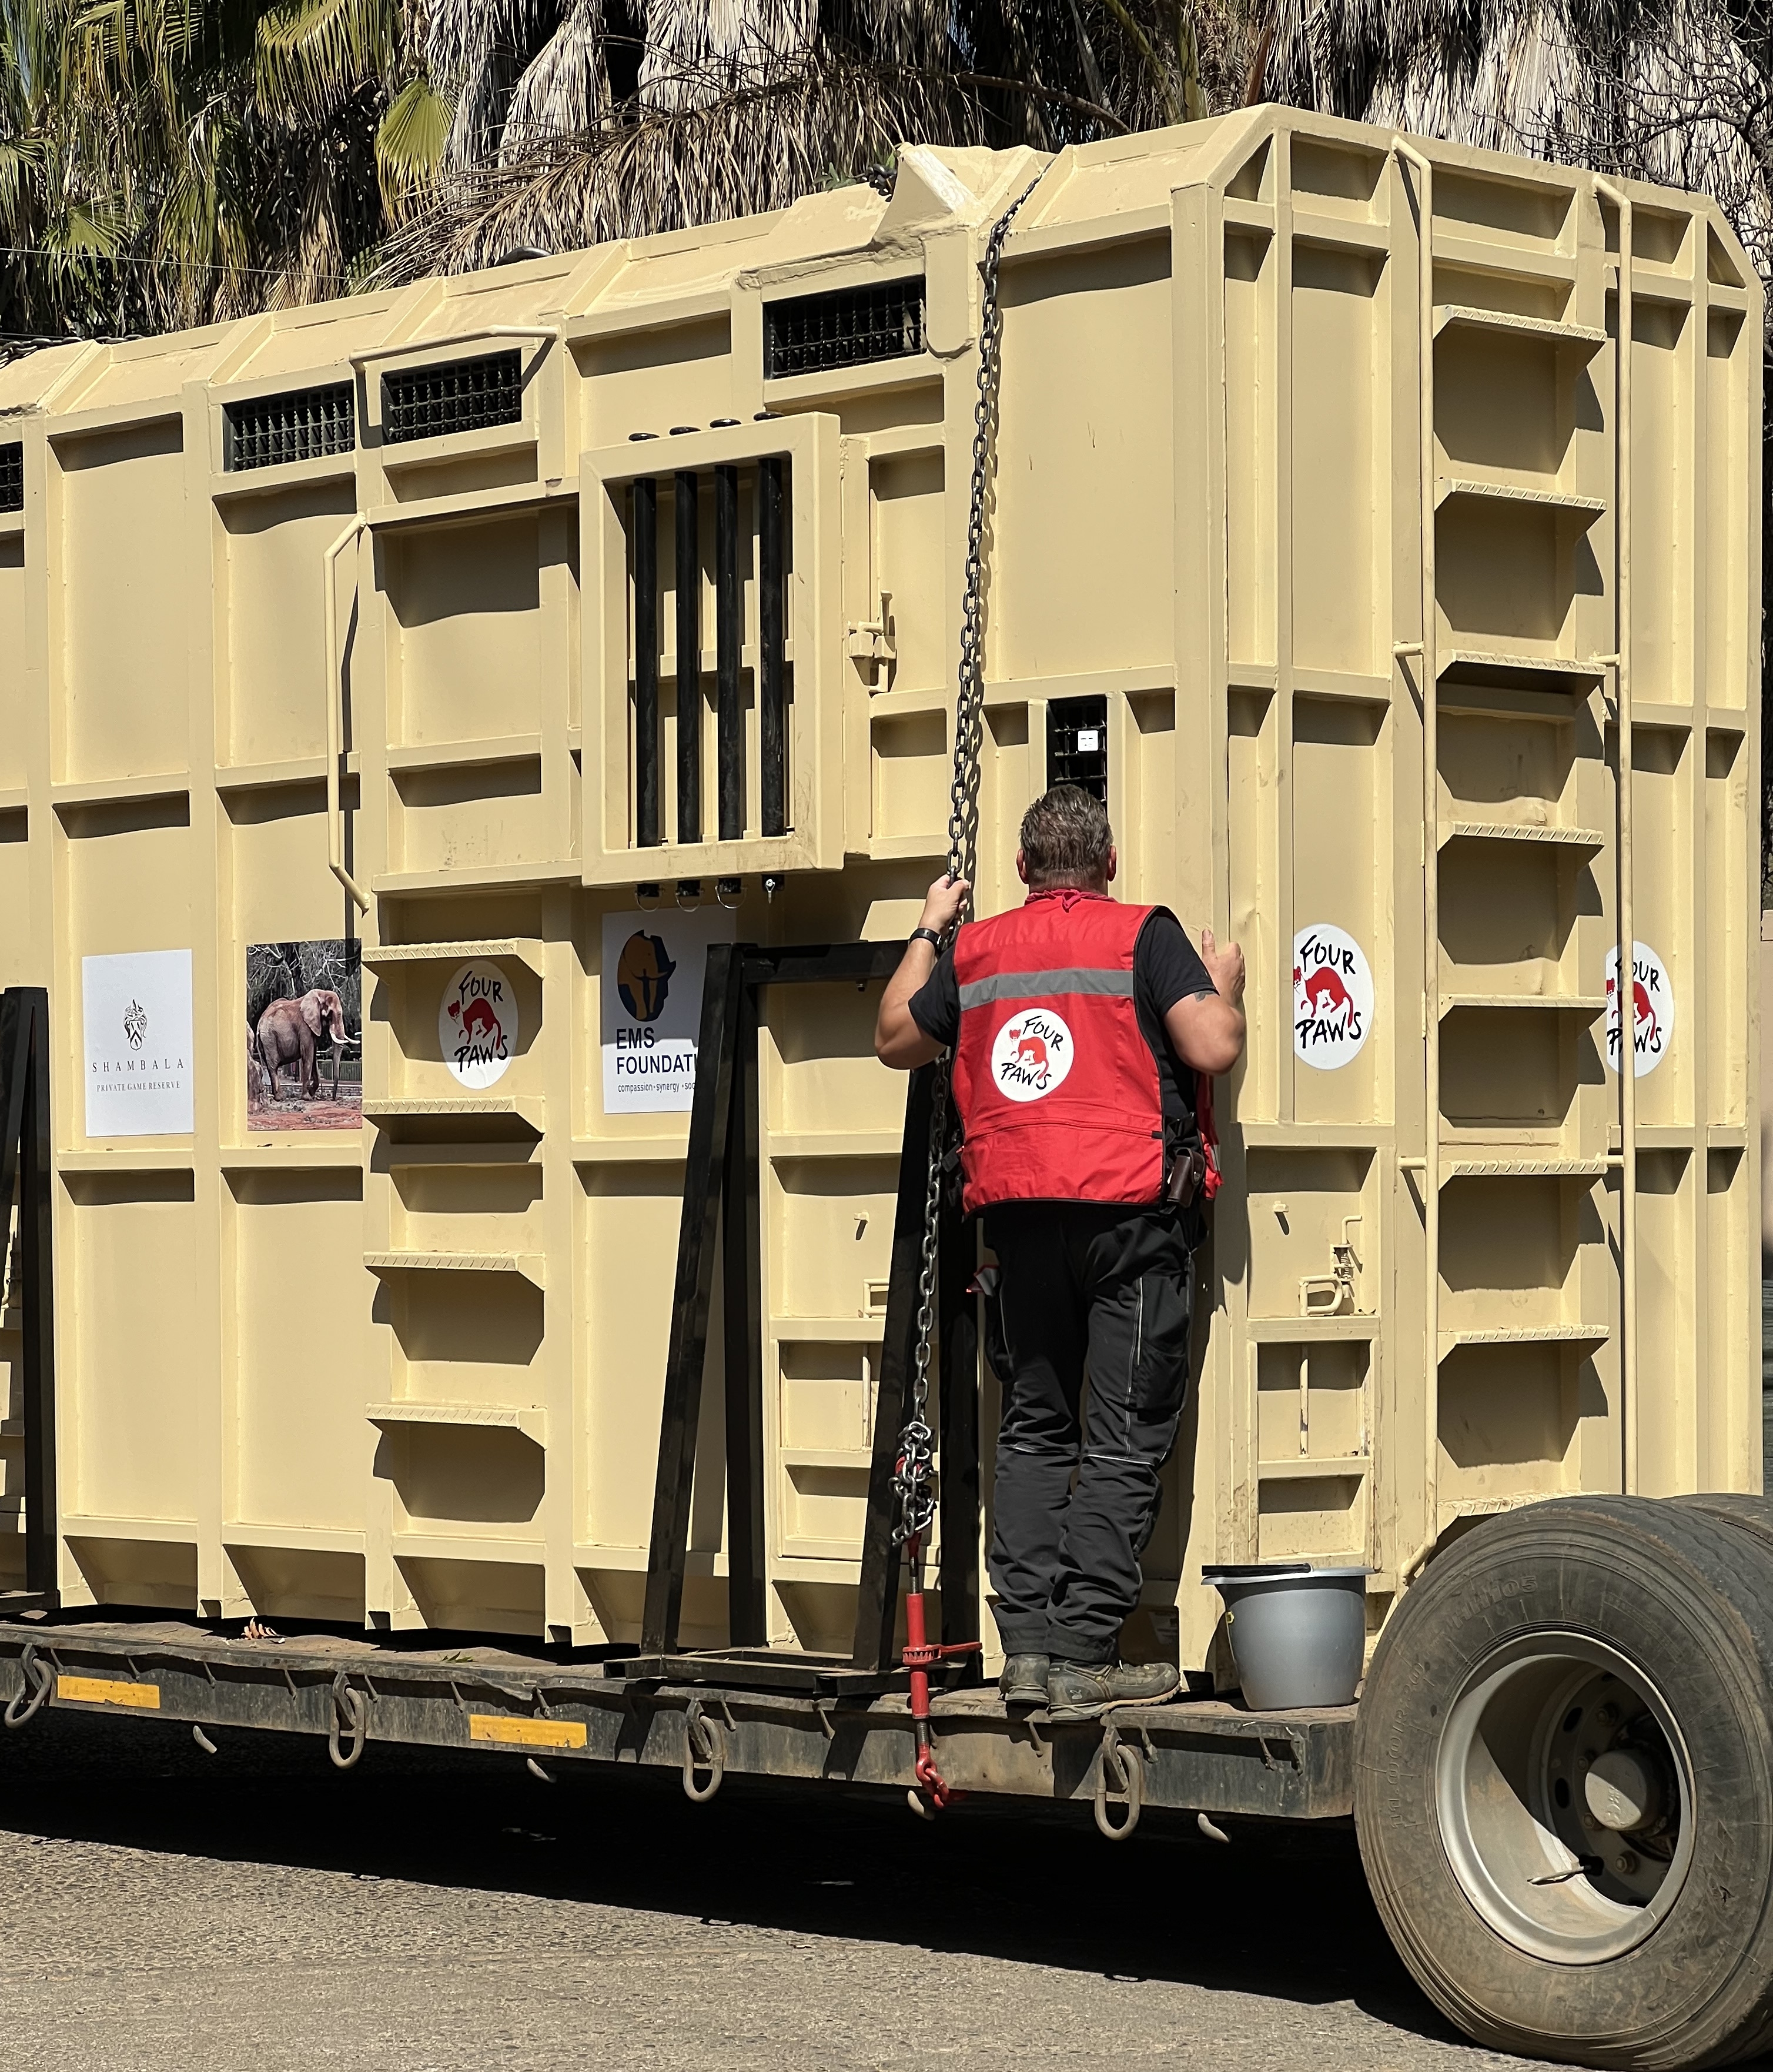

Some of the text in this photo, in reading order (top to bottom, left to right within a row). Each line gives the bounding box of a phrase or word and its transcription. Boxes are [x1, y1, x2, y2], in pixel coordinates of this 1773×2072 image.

[1300, 934, 1356, 974] FOUR
[459, 970, 504, 1003] FOUR
[616, 1027, 655, 1050] EMS
[1023, 1015, 1063, 1051] FOUR
[1295, 1011, 1361, 1049] PAWS
[1607, 1025, 1662, 1055] PWS
[92, 1058, 183, 1072] SHAMBALA
[454, 1035, 508, 1072] PAWS
[96, 1081, 180, 1092] PRIVATE GAME RESERVE
[1001, 1062, 1052, 1090] PAWS
